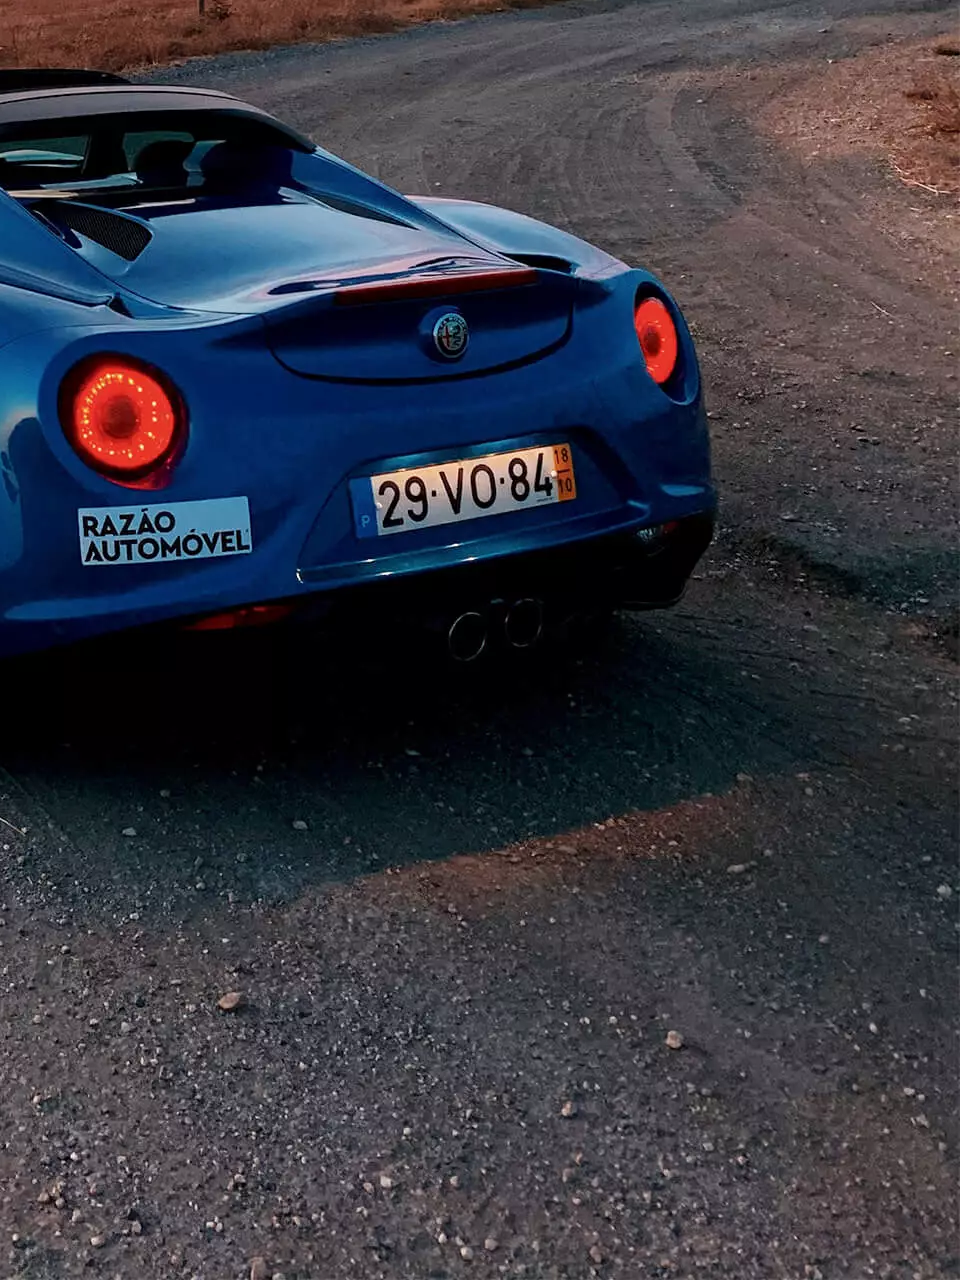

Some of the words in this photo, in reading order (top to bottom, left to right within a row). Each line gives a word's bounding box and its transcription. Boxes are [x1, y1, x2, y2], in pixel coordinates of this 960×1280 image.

[554, 447, 569, 464] 18
[558, 477, 573, 494] 10
[82, 507, 176, 537] RAZÃO
[84, 528, 250, 563] AUTOMÓVEL
